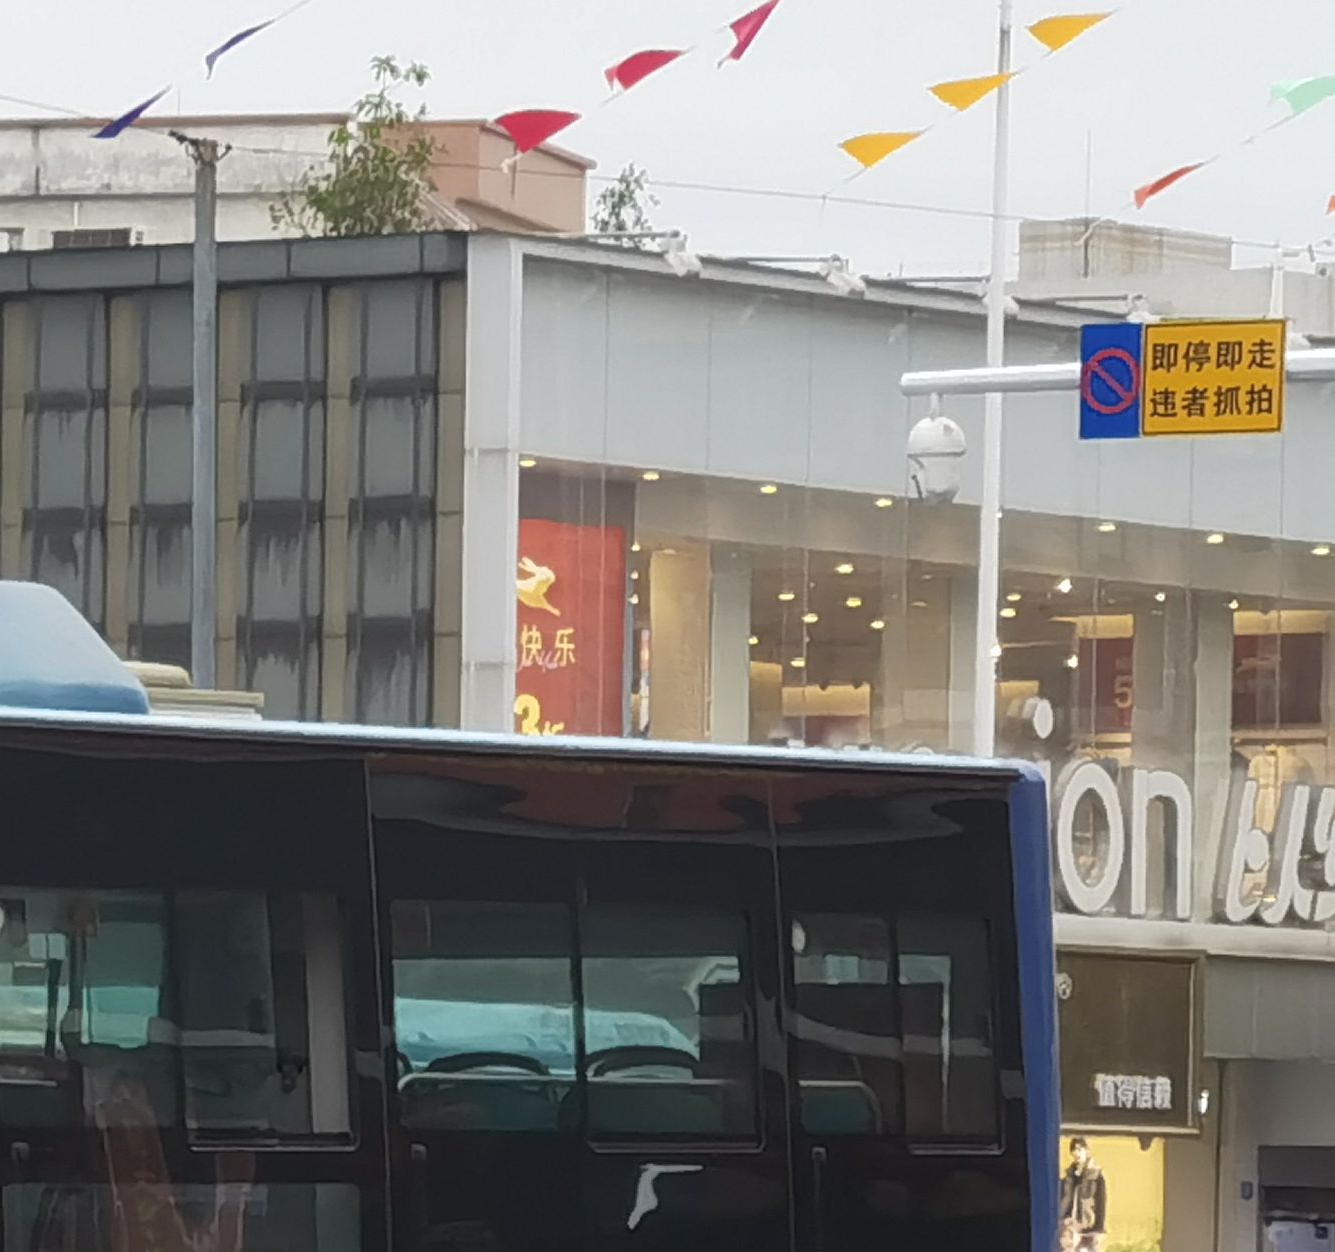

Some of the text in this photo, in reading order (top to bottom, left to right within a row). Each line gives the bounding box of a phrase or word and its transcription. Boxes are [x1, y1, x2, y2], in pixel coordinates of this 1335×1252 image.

[1151, 338, 1276, 374] 即停即走
[1149, 384, 1274, 418] 违者抓拍
[520, 623, 576, 668] 快乐
